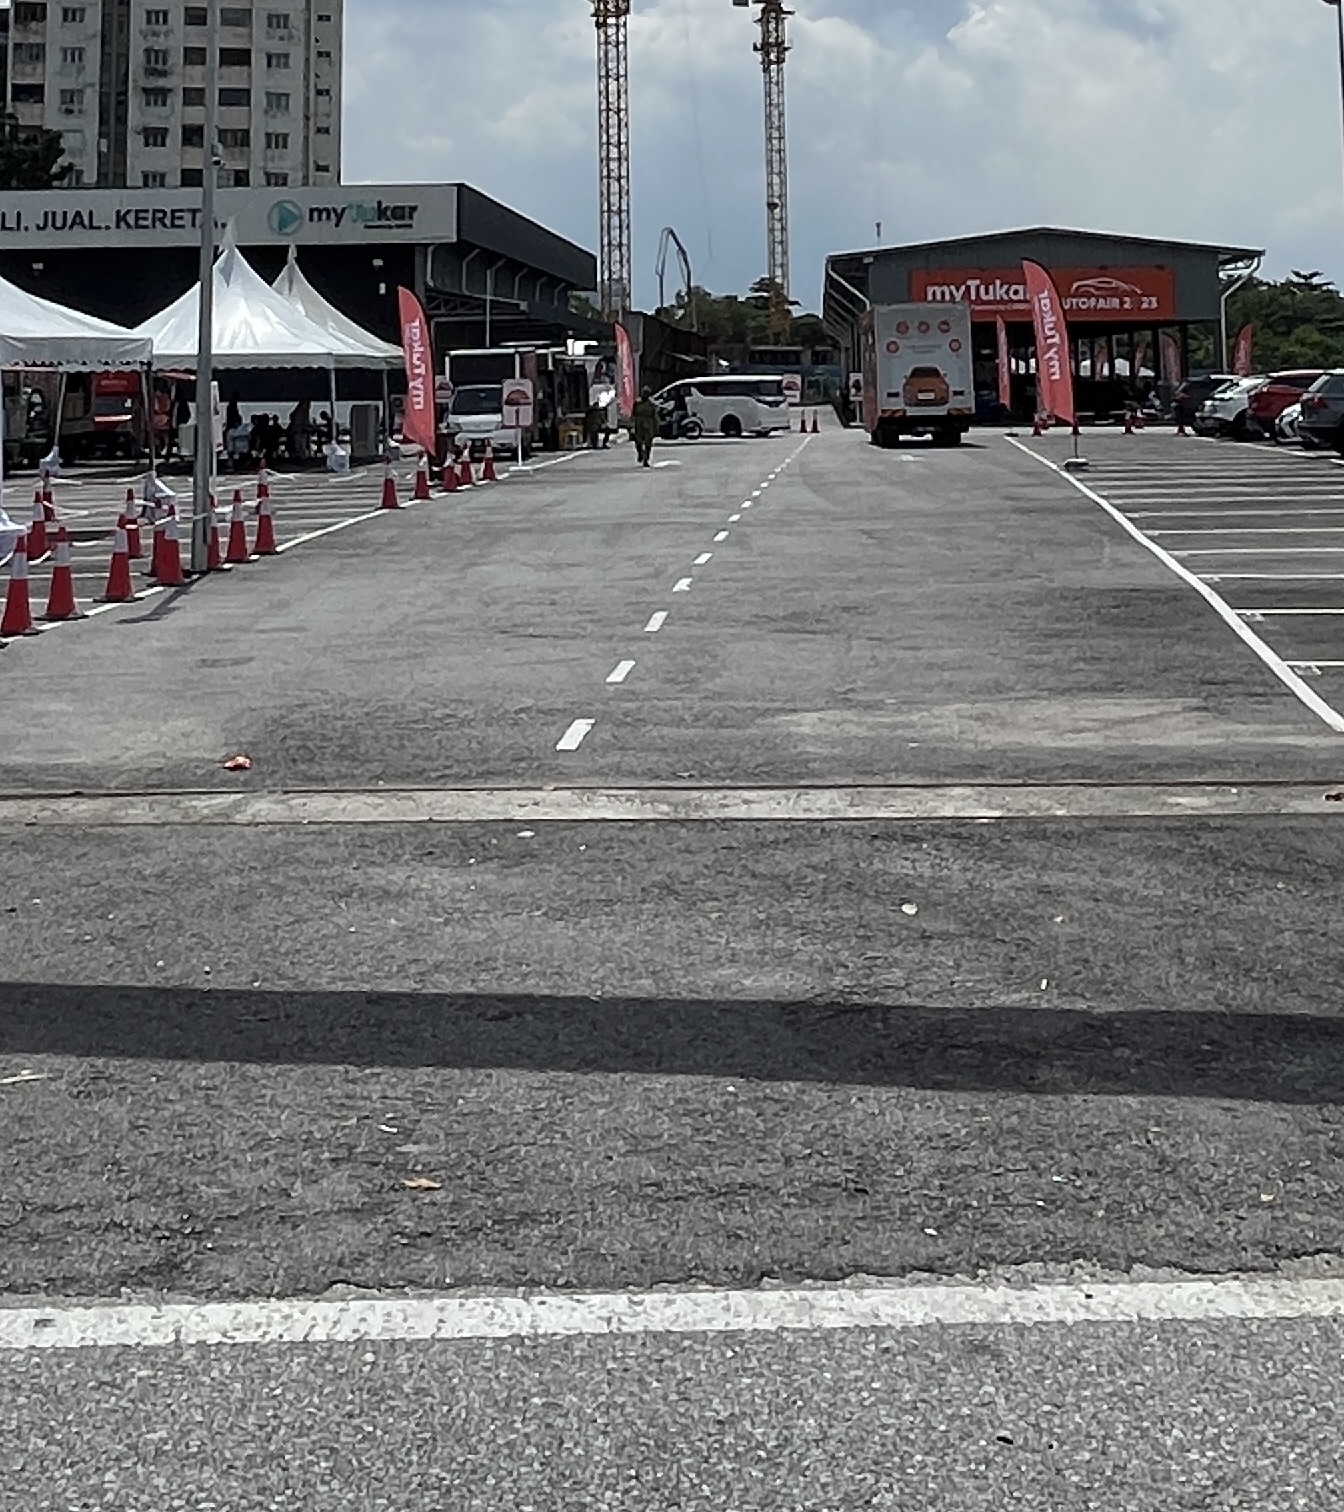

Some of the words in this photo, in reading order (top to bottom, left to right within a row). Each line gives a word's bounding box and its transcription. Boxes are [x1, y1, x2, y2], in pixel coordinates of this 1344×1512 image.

[35, 208, 112, 231] JUAL.
[114, 207, 228, 231] KERET.
[926, 278, 1030, 303] myTuka
